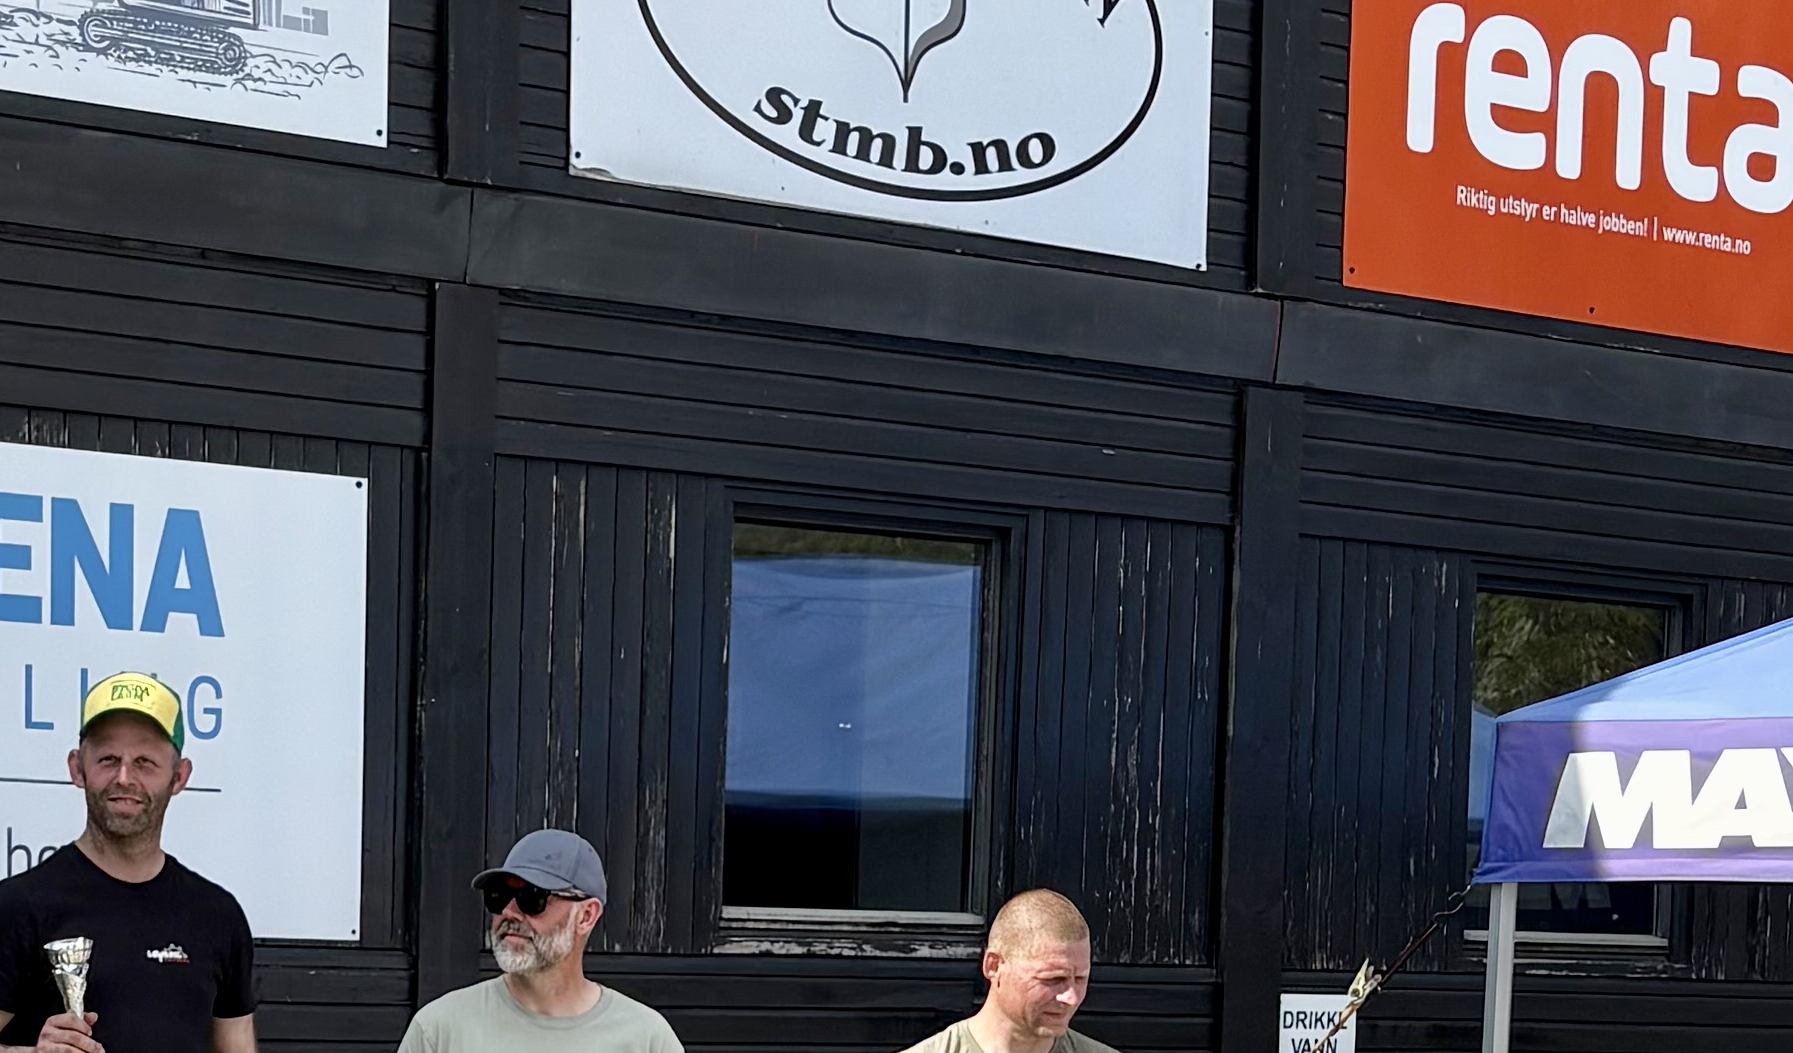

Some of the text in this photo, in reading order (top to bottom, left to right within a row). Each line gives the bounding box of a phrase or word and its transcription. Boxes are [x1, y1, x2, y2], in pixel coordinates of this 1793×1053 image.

[752, 86, 1057, 176] stmb.no
[1406, 2, 1793, 214] renta
[1456, 185, 1751, 255] Riktig utstyr er halve jobben! www.renta.no
[1542, 746, 1793, 850] MA
